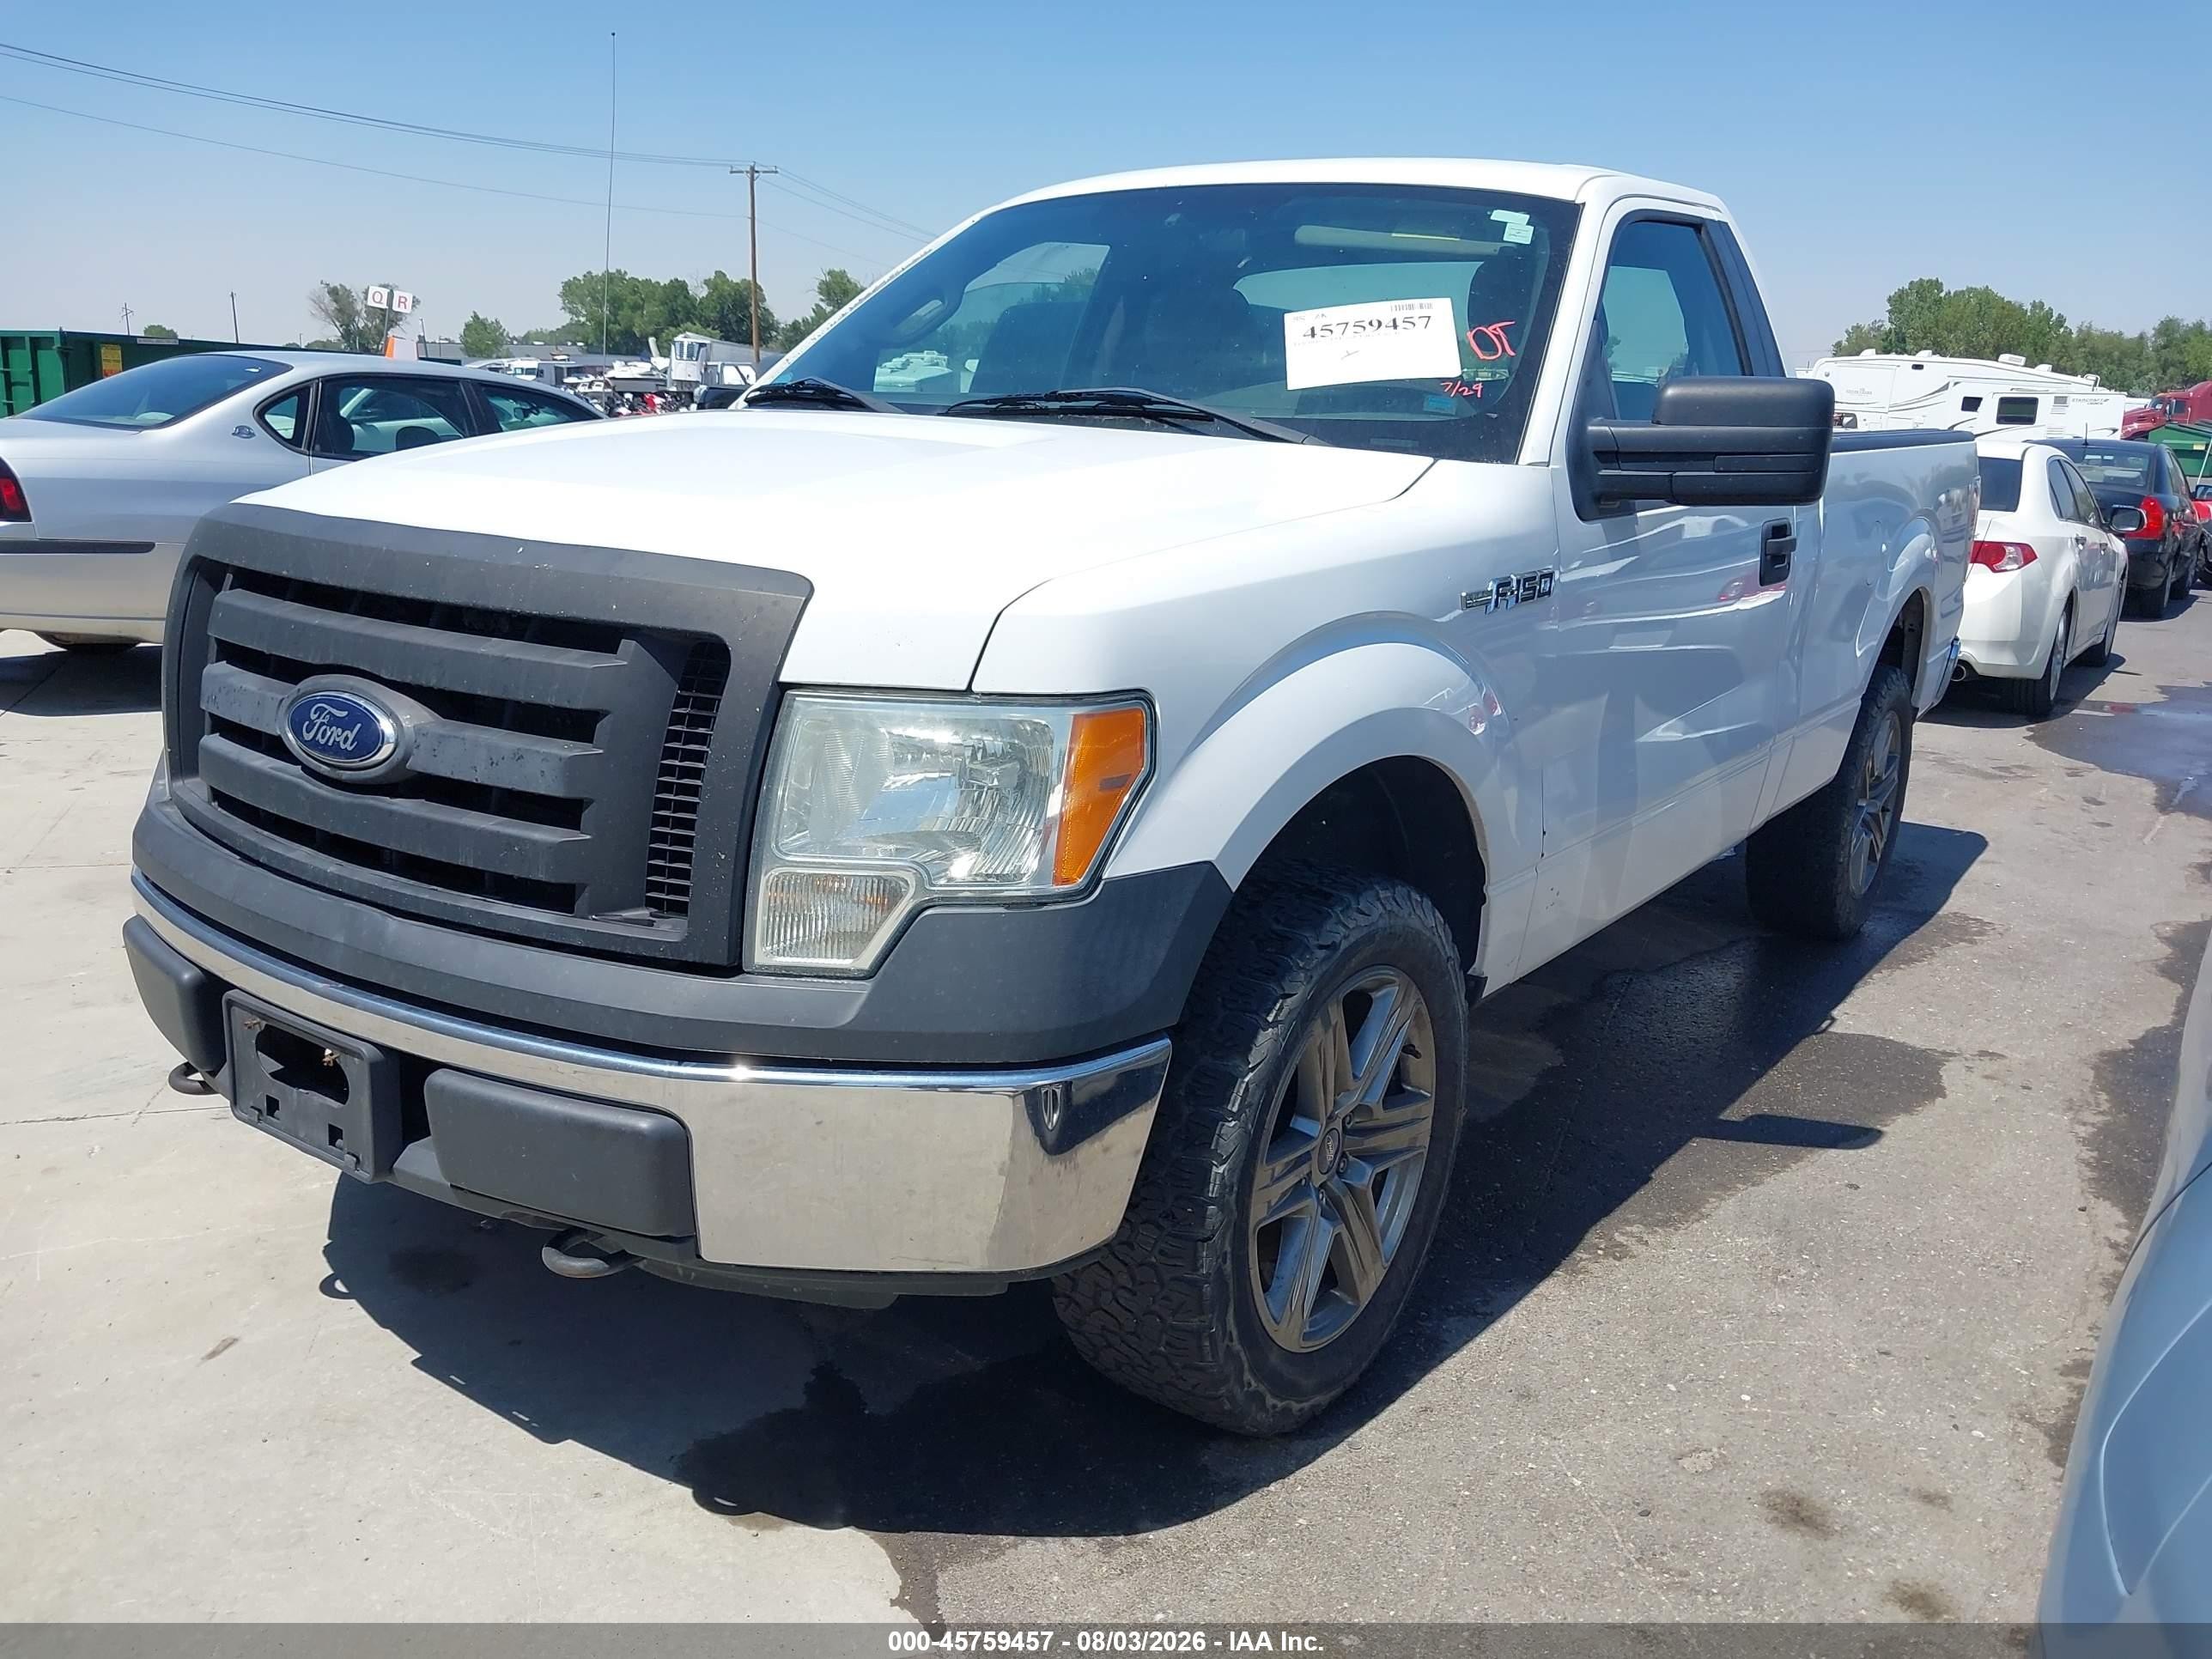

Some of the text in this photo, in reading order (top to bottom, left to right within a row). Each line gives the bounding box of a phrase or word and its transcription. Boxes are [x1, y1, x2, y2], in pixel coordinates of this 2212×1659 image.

[372, 290, 384, 305] Q
[398, 295, 408, 310] R
[1302, 314, 1432, 339] 45759457
[1440, 380, 1484, 398] 7/29
[302, 702, 362, 751] Ford
